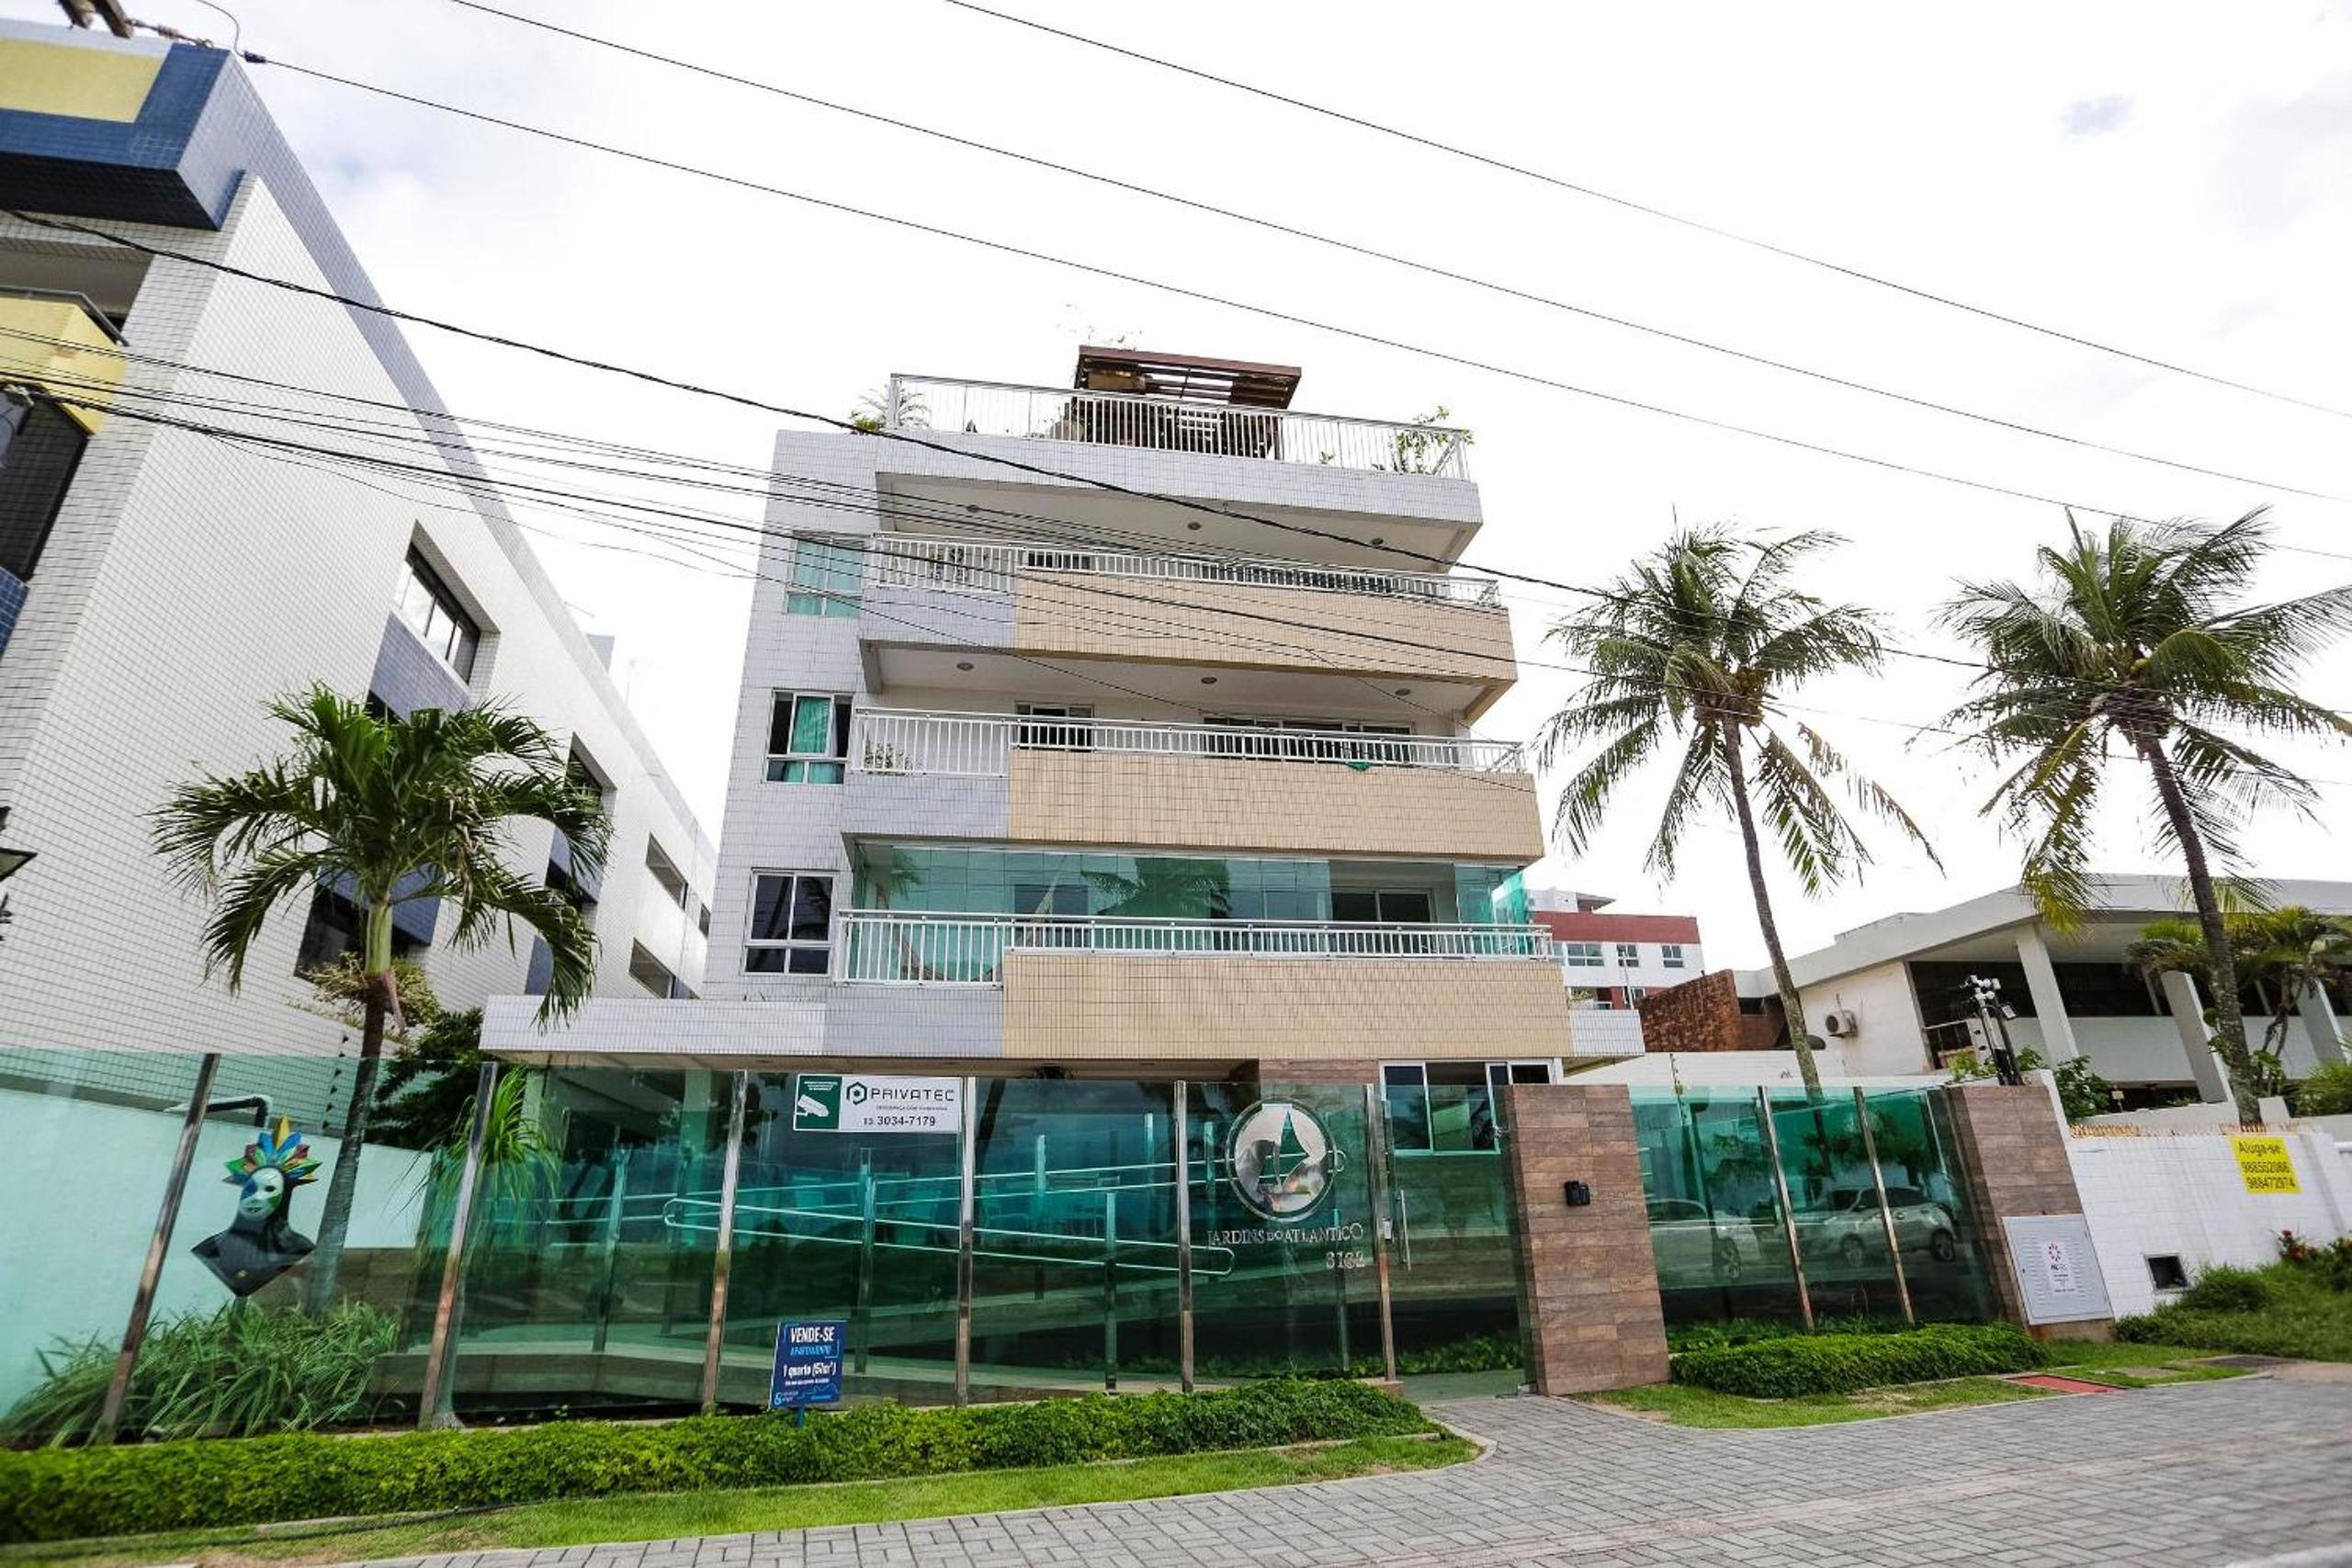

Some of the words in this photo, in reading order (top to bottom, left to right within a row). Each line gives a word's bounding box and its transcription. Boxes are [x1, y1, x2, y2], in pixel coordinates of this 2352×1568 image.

[872, 1088, 955, 1101] PRIVATEC
[877, 1115, 935, 1126] 3034-7179
[1207, 1229, 1265, 1246] JARDINS
[791, 1326, 835, 1343] VENDE-SE
